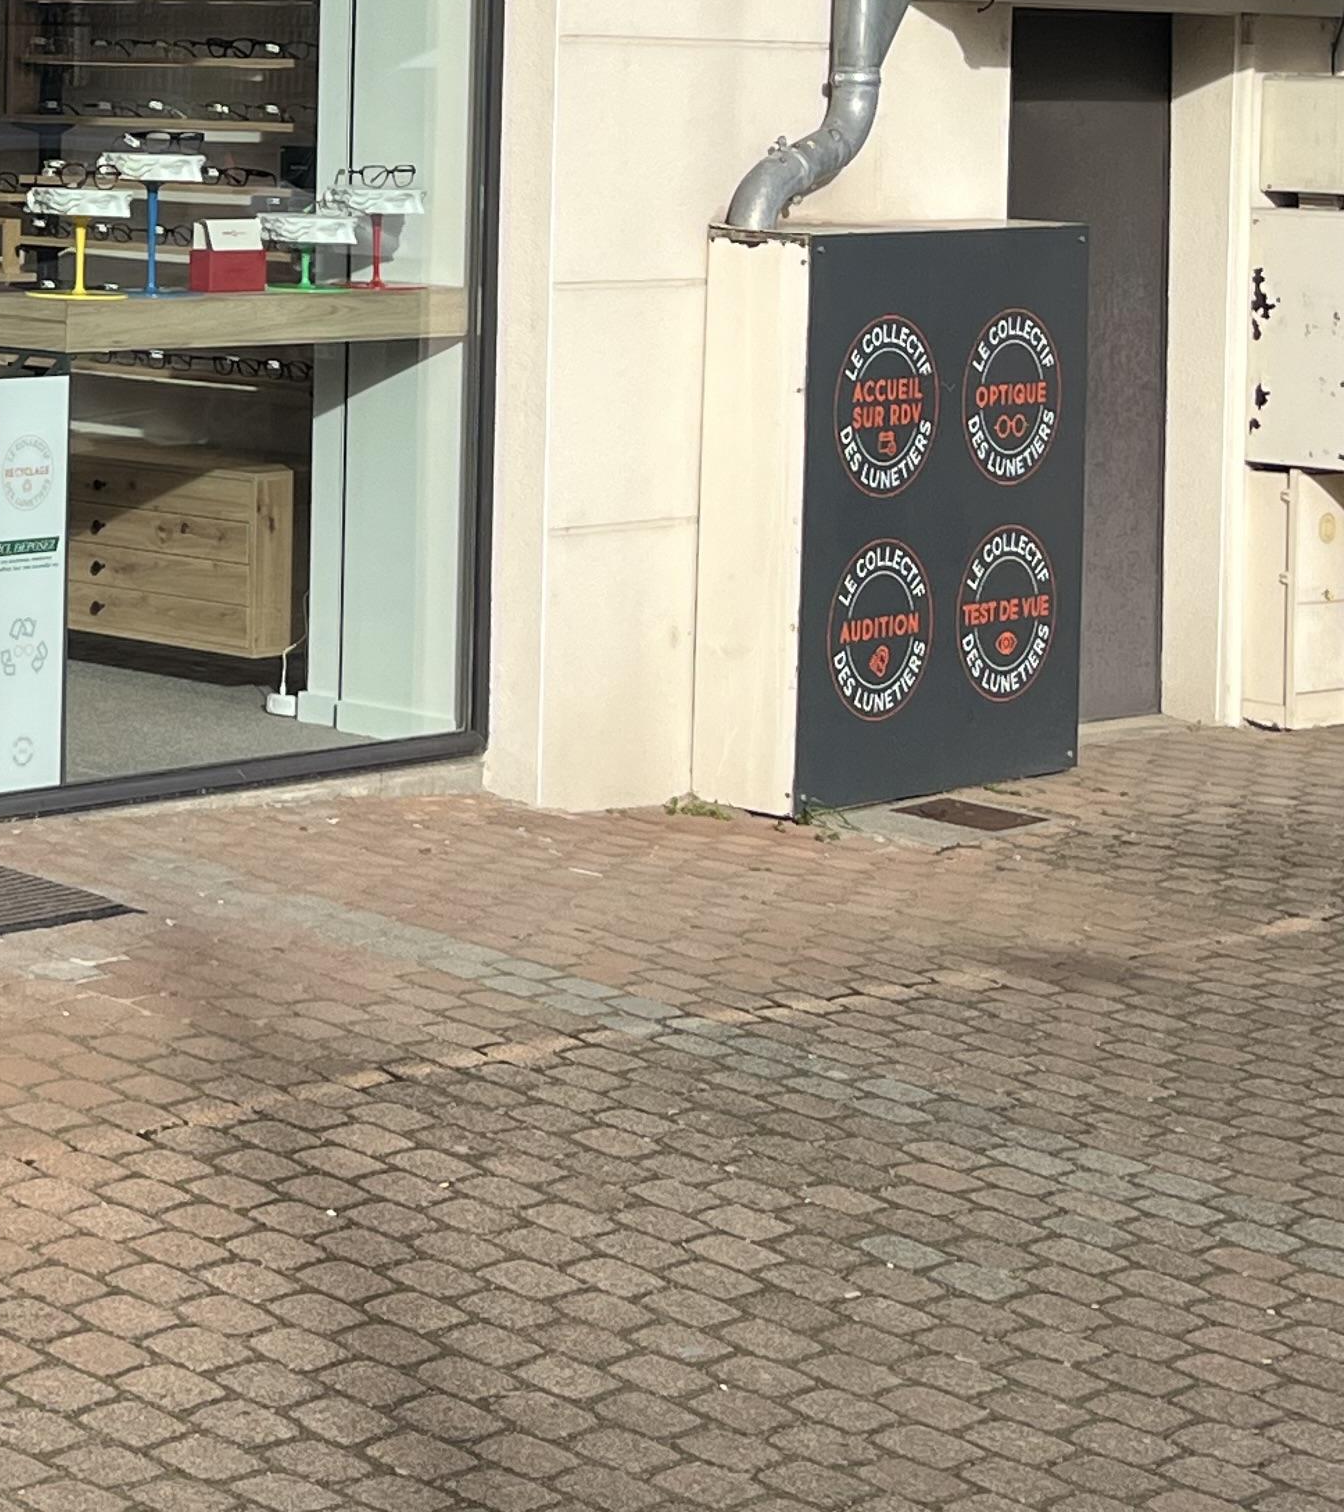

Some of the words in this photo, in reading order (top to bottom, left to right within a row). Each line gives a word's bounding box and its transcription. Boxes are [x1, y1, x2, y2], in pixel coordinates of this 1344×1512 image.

[845, 348, 863, 381] LE
[862, 323, 932, 376] COLLECTIF
[972, 341, 991, 373] LE
[989, 316, 1054, 369] COLLECTIF
[853, 376, 923, 403] ACCUEIL
[853, 405, 885, 429] SUR
[889, 402, 923, 426] RDV
[975, 381, 1047, 408] OPTIQUE
[840, 425, 862, 472] DES
[861, 419, 932, 489] LUNETIERS
[968, 414, 989, 460] DES
[987, 409, 1055, 477] LUNETIERS
[5, 466, 50, 479] RECYCLAGE
[838, 574, 858, 607] LE
[856, 545, 925, 598] COLLECTIF
[966, 558, 985, 591] LE
[983, 532, 1049, 584] COLLECTIF
[840, 612, 919, 644] AUDITION
[963, 601, 996, 626] TEST
[999, 597, 1019, 622] DE
[1022, 595, 1050, 618] VUE
[833, 650, 856, 697] DES
[853, 640, 925, 712] LUNETIERS
[962, 633, 983, 678] DES
[982, 623, 1050, 693] LUNETIERS
